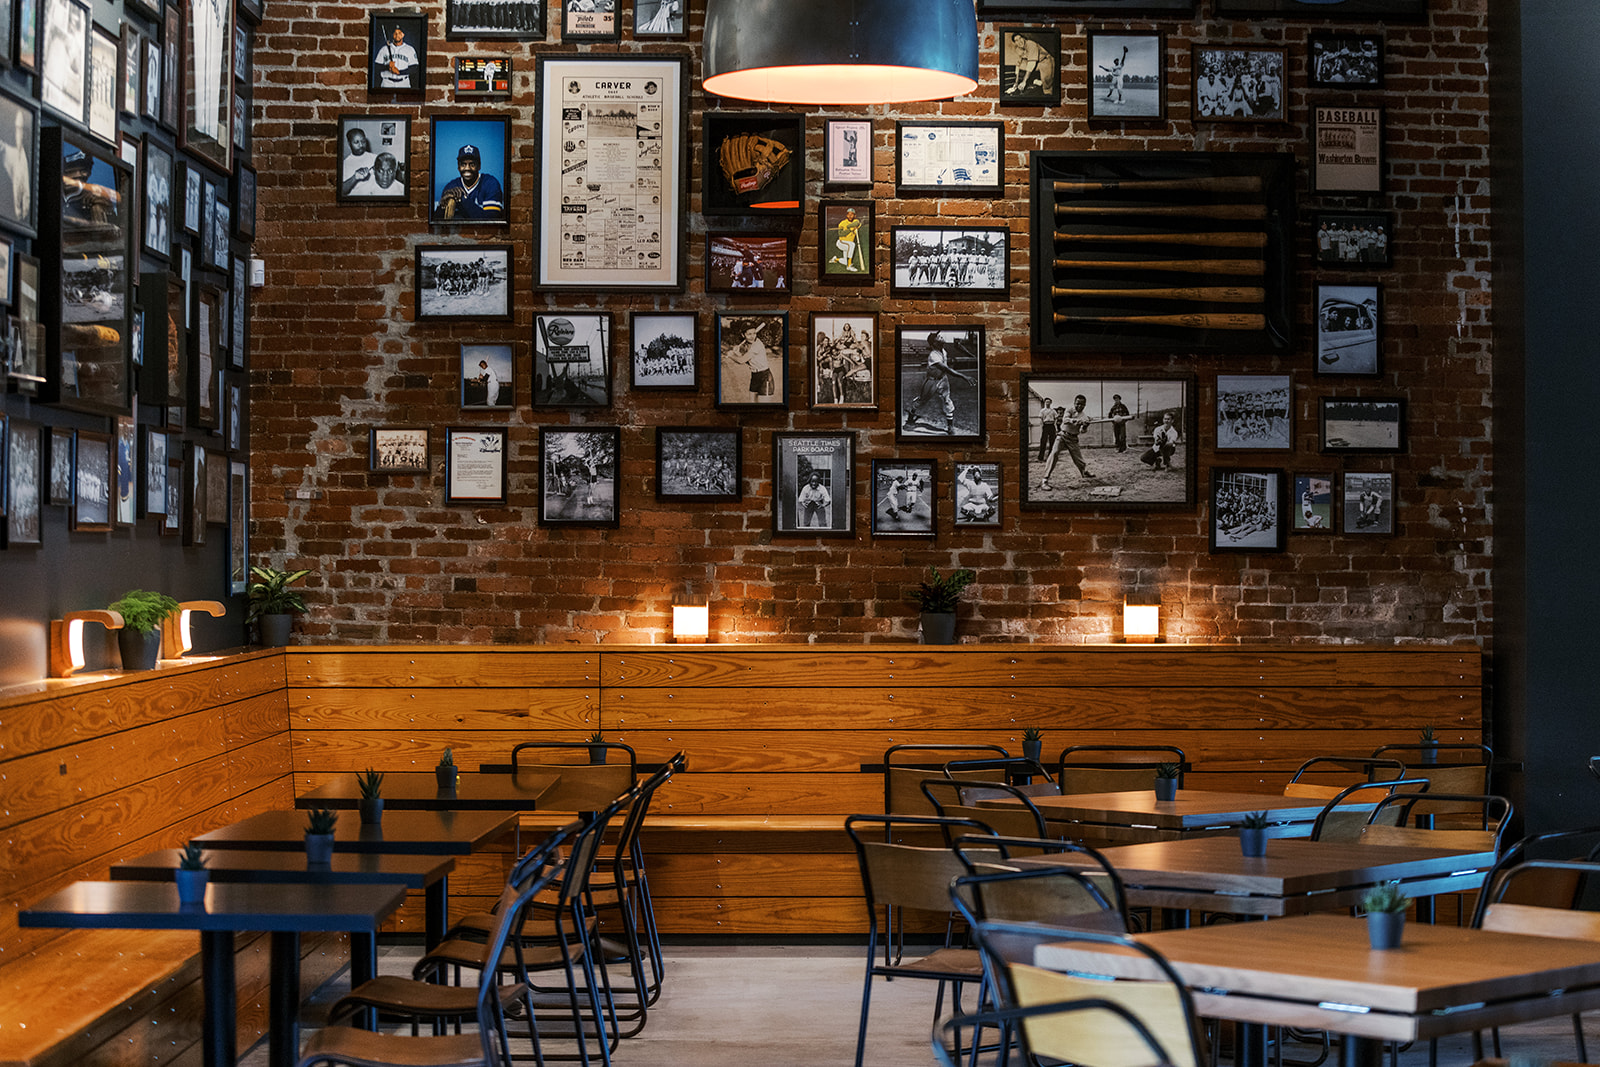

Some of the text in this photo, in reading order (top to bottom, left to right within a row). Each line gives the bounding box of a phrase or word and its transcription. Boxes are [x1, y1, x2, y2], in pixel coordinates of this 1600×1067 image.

[383, 54, 409, 62] MRINERS
[595, 81, 632, 90] CARVER
[1318, 110, 1377, 122] BASEBALL
[1318, 153, 1354, 165] Washington
